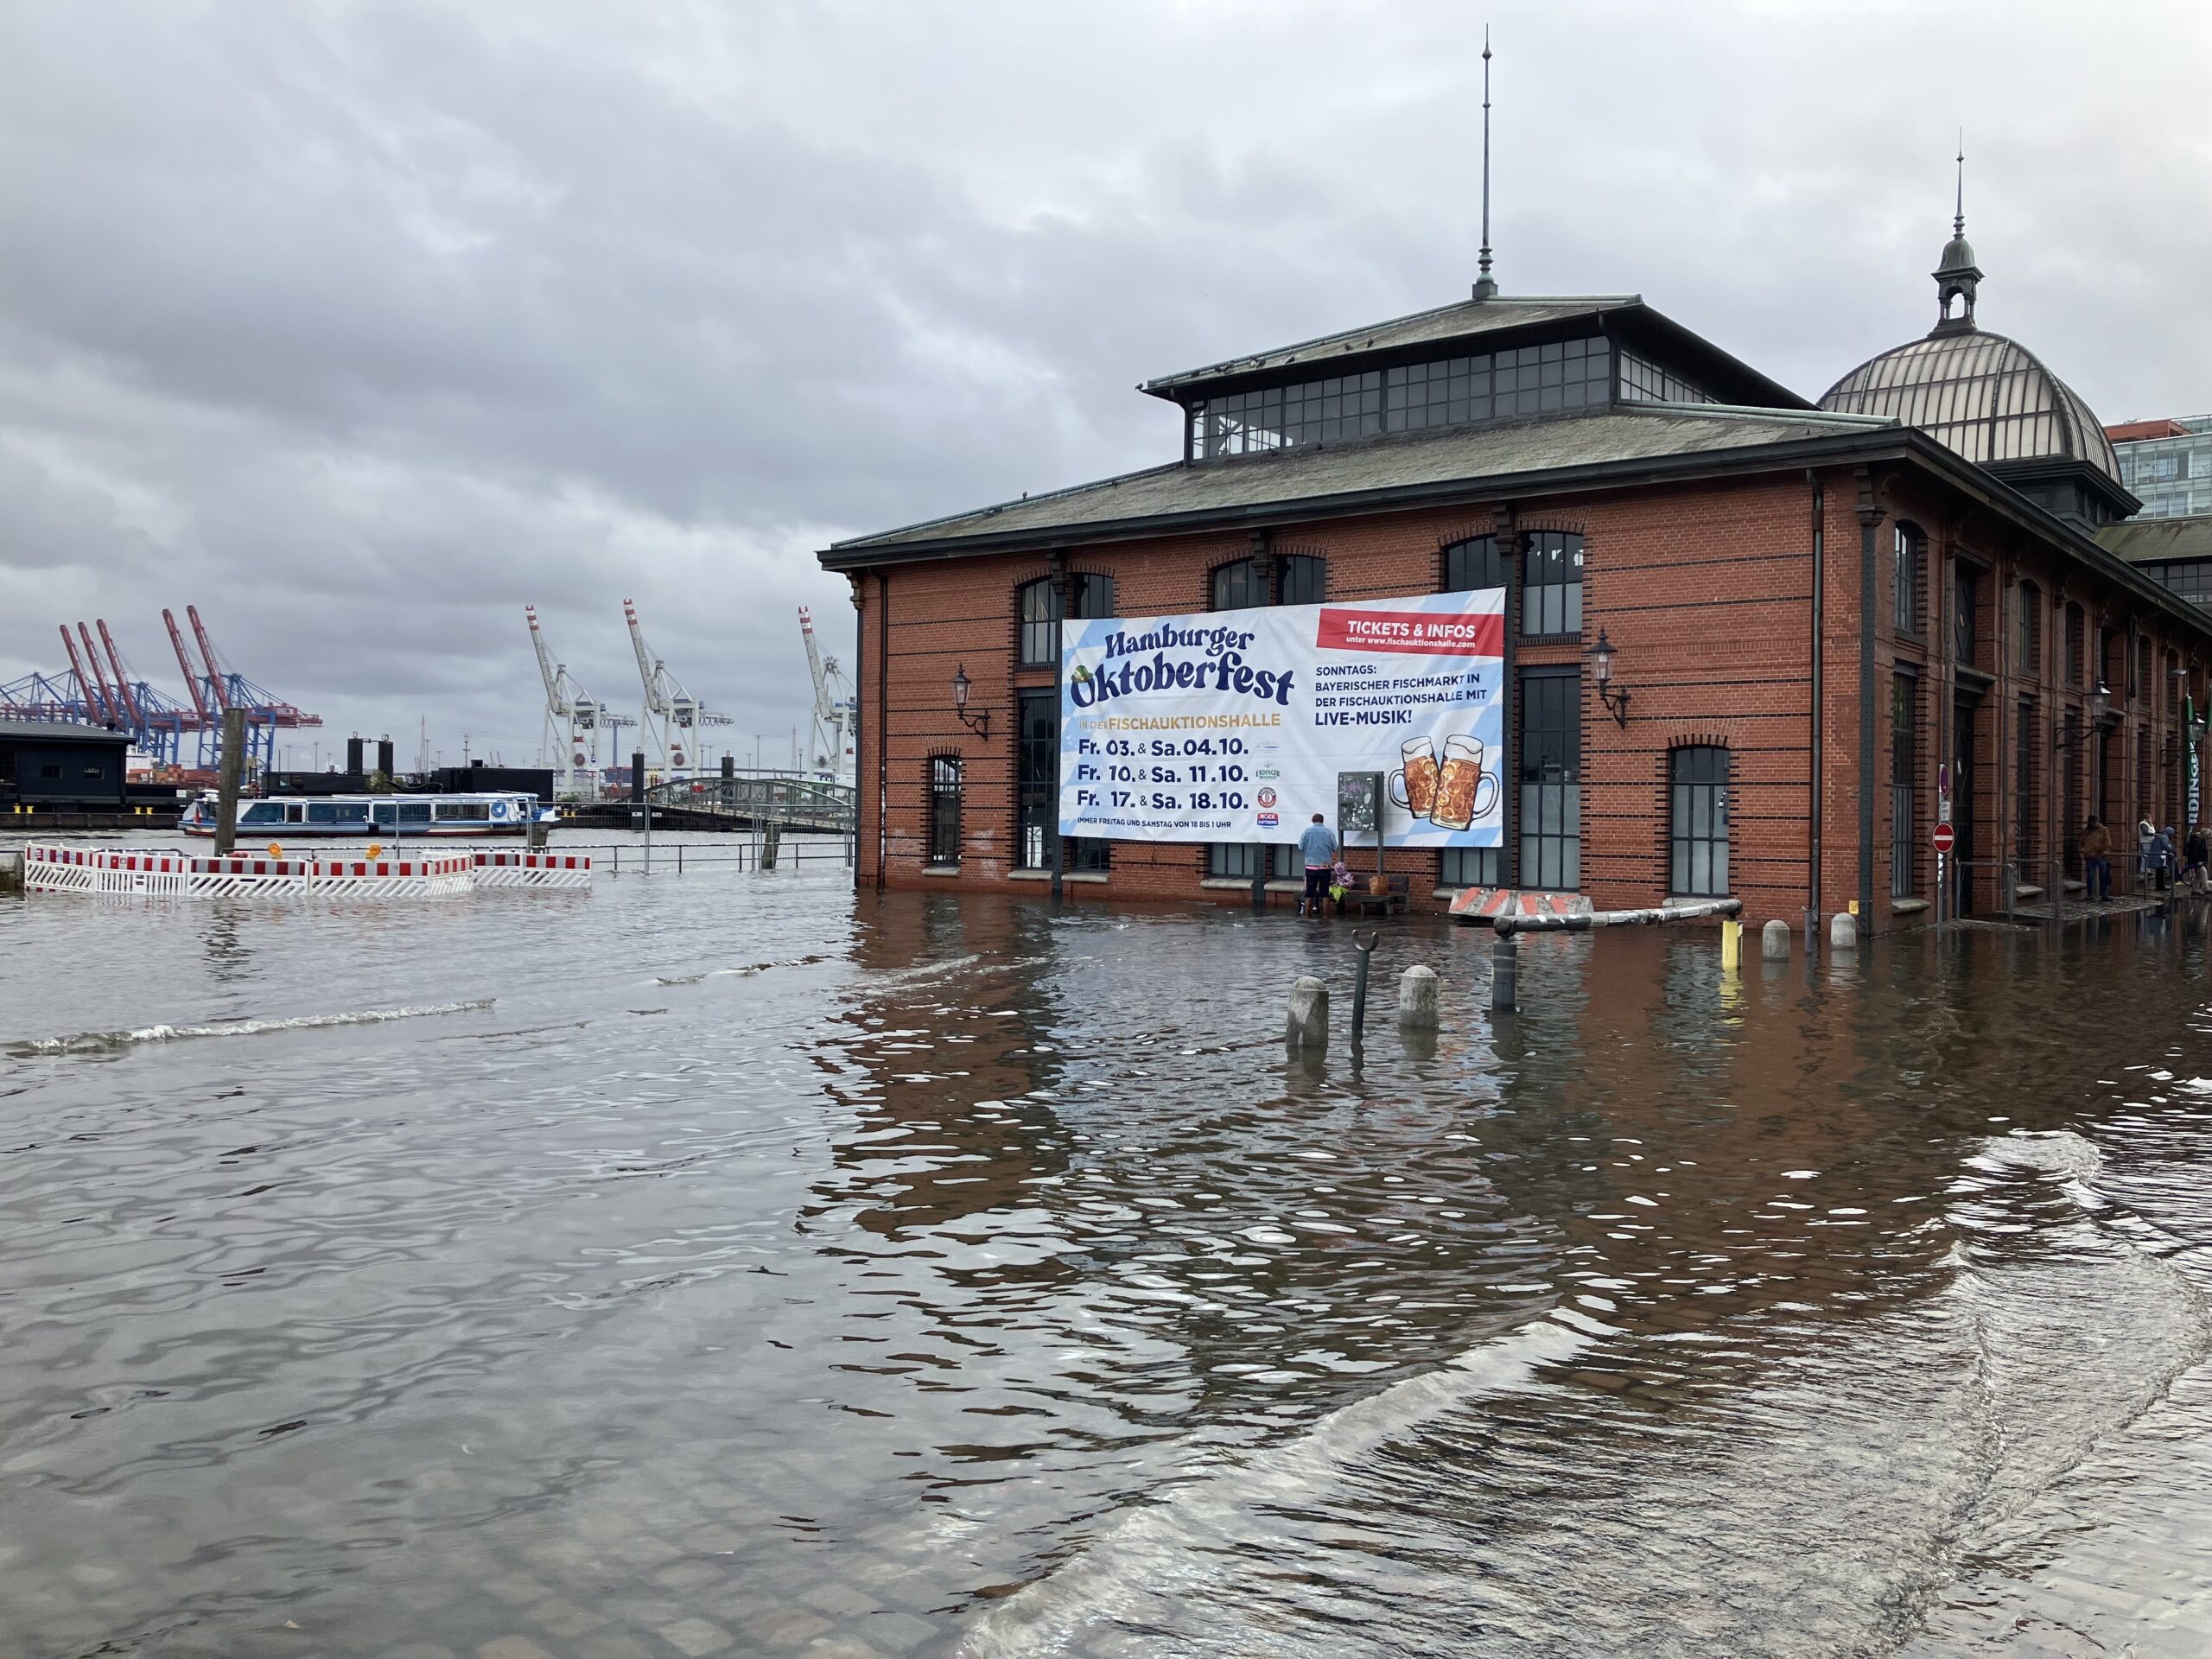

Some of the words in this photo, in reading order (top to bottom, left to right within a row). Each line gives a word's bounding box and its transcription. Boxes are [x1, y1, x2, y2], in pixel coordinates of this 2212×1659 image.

[1348, 620, 1409, 636] TICKETS
[1413, 623, 1424, 637] &
[1427, 624, 1476, 639] INFOS
[1104, 623, 1255, 659] Hamburger
[1367, 637, 1476, 648] www.fischauktionshalle.com
[1316, 664, 1377, 677] SONNTAGS:
[1071, 651, 1295, 708] Oktoberfest
[1315, 679, 1389, 691] BAYERISCHER
[1393, 675, 1465, 689] FISCHMARKT
[1467, 674, 1480, 684] IN
[1315, 697, 1337, 707] DER
[1339, 691, 1463, 707] FISCHAUKTIONSHALLE
[1466, 690, 1487, 700] MIT
[1078, 720, 1088, 729] IN
[1090, 721, 1108, 729] DER
[1109, 713, 1281, 730] FISCHAUKTIONSHALLE
[1315, 710, 1412, 726] LIVE-MUSIK!
[1078, 739, 1100, 755] Fr.
[1106, 740, 1135, 757] 03.
[1137, 743, 1147, 754] &
[1151, 740, 1181, 757] Sa.
[1184, 738, 1249, 756] 04.10.
[1077, 764, 1101, 780] Fr.
[1109, 766, 1135, 783] 10.
[1138, 769, 1147, 780] &
[1151, 766, 1182, 783] Sa.
[1189, 765, 1249, 783] 11.10.
[1255, 769, 1281, 778] ERDINGER
[1077, 790, 1100, 806] Fr.
[1111, 791, 1135, 808] 17.
[1140, 795, 1147, 807] &
[1152, 792, 1182, 809] Sa.
[1189, 791, 1249, 809] 18.10.
